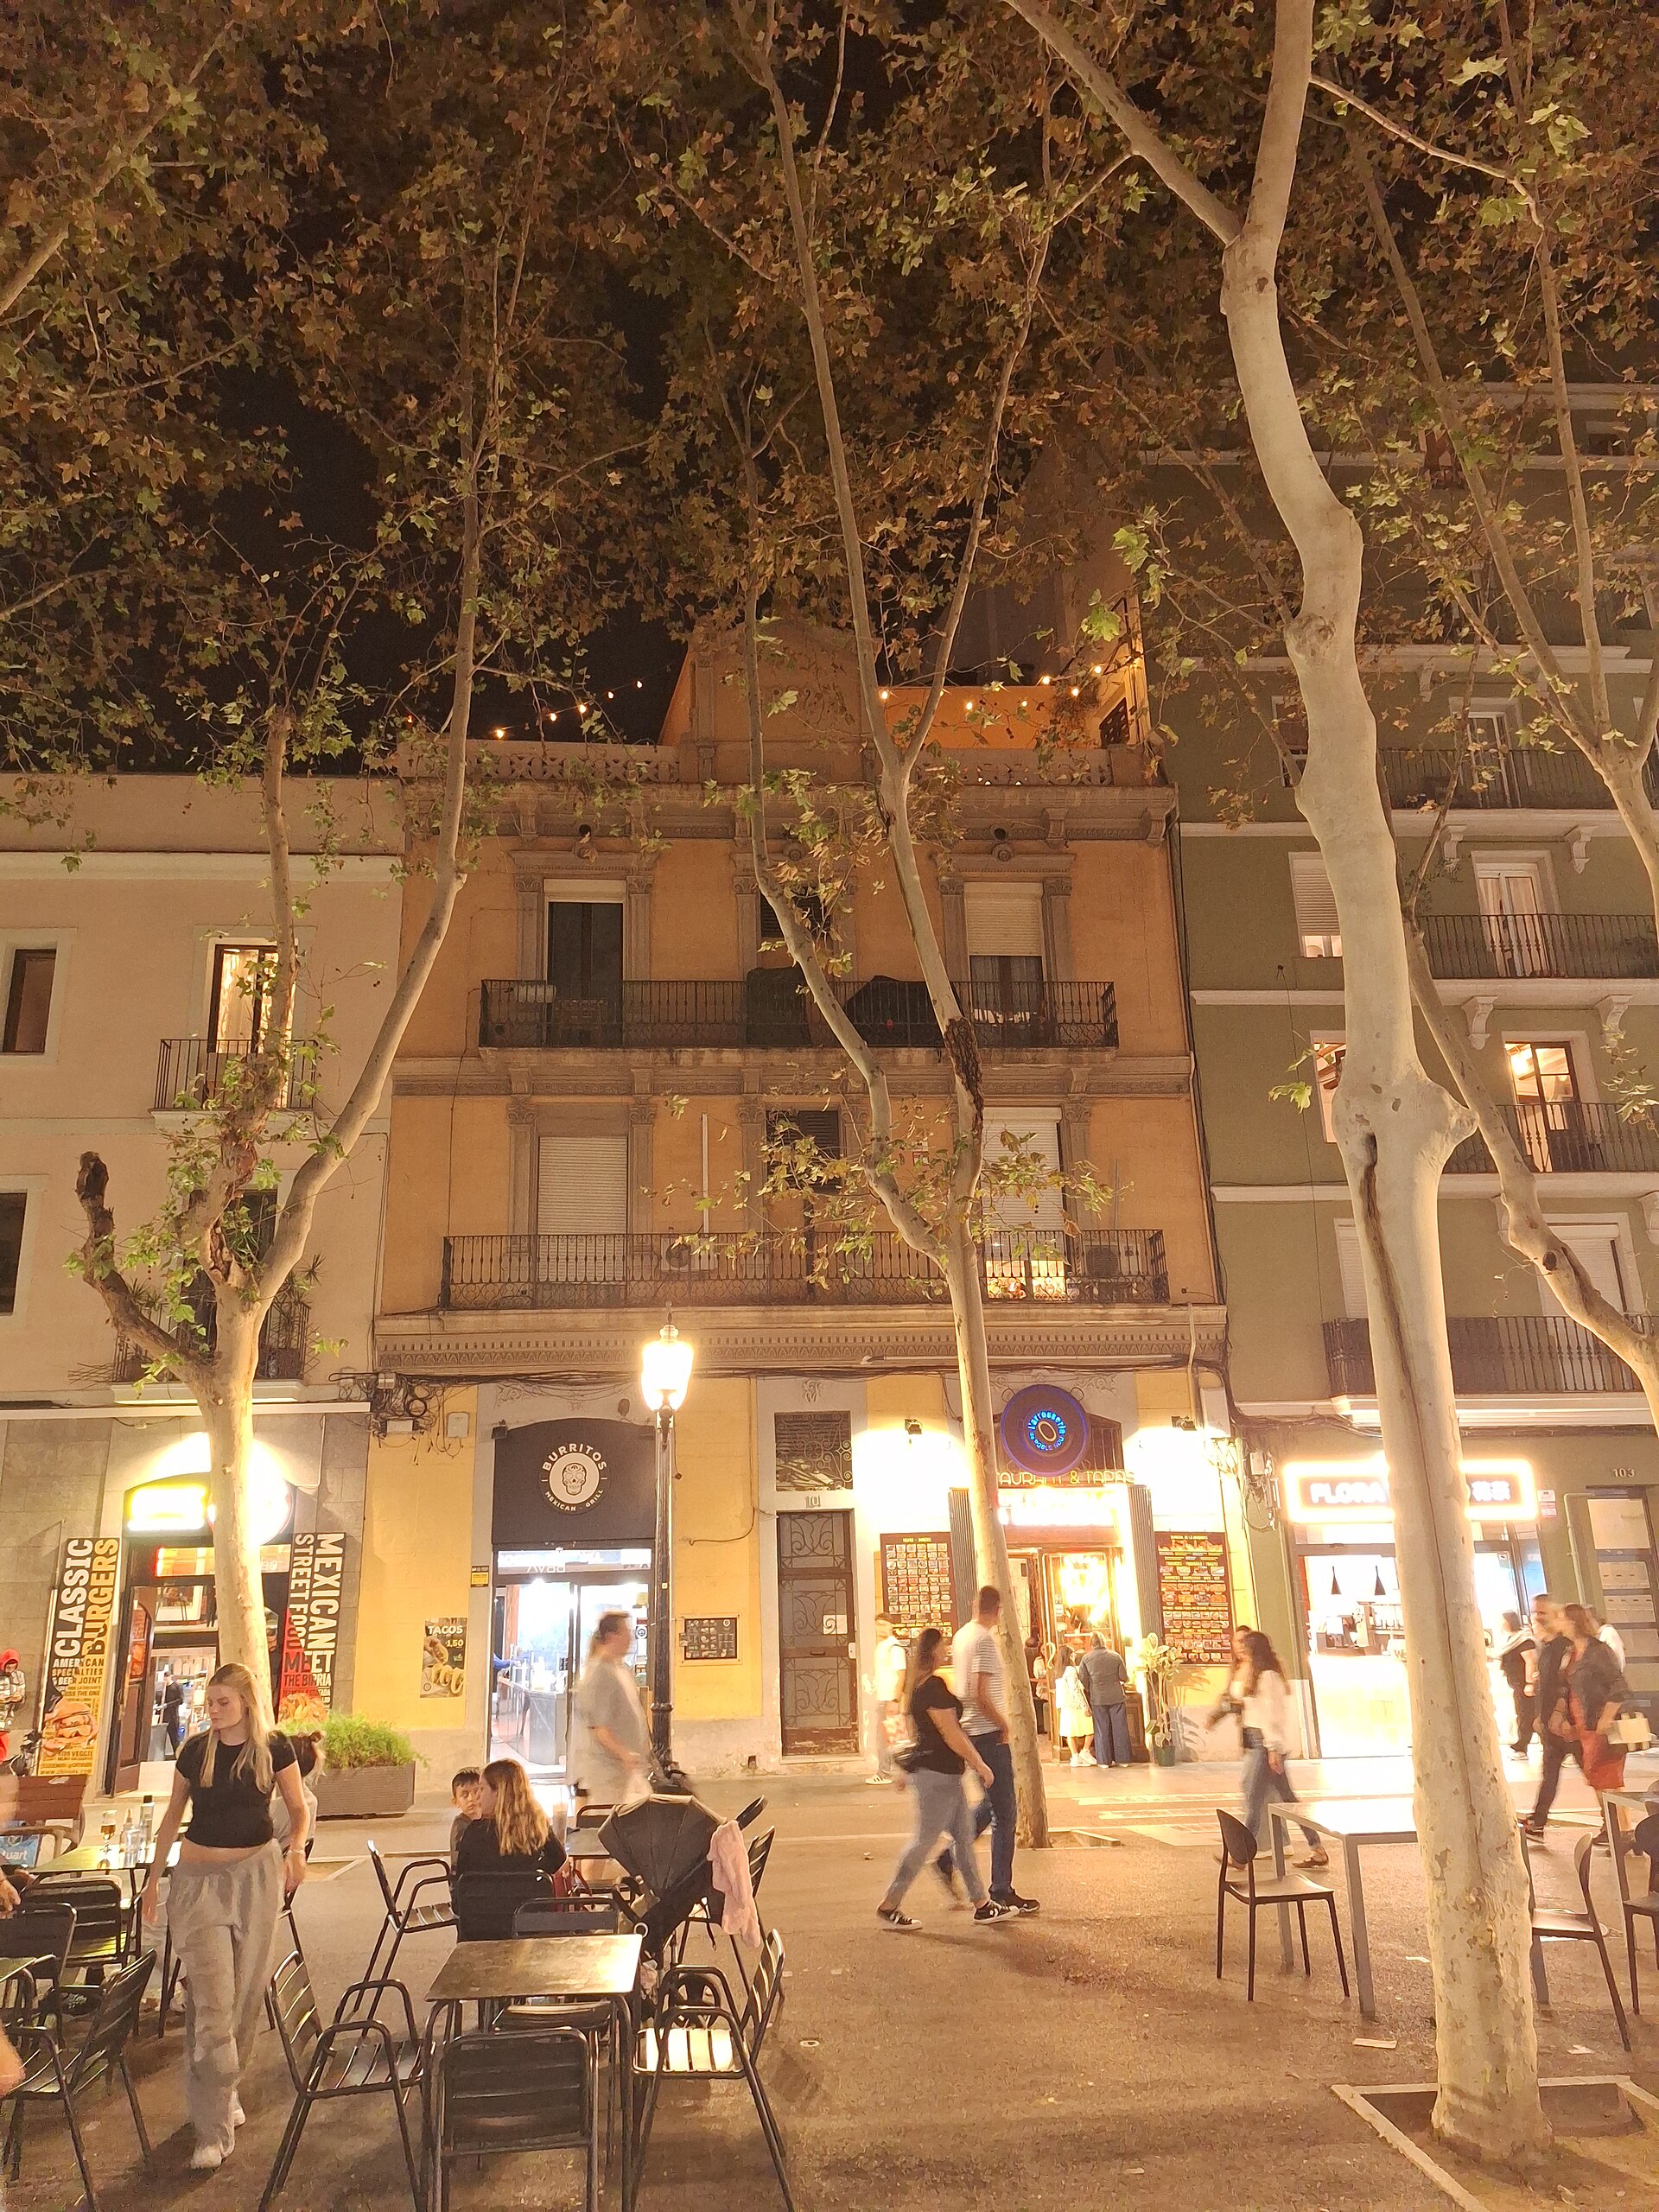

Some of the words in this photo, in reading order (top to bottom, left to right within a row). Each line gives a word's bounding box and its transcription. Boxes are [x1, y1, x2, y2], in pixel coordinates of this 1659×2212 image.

[542, 1443, 607, 1471] BURRITOS
[1070, 1470, 1080, 1484] &
[1085, 1471, 1135, 1484] TAPAS
[1612, 1468, 1635, 1478] 103
[545, 1491, 576, 1511] MEXICAN
[585, 1489, 604, 1508] GRILL
[290, 1534, 315, 1600] STREET
[54, 1539, 93, 1657] CLASSIC
[81, 1538, 119, 1656] BURGERS
[307, 1533, 345, 1649] MEXICAN
[427, 1625, 463, 1635] TACOS
[53, 1658, 105, 1669] AMERICAN
[284, 1650, 335, 1673] MEET
[52, 1668, 103, 1677] SPECIALTIES
[78, 1676, 102, 1685] JOINT
[283, 1675, 303, 1687] THE
